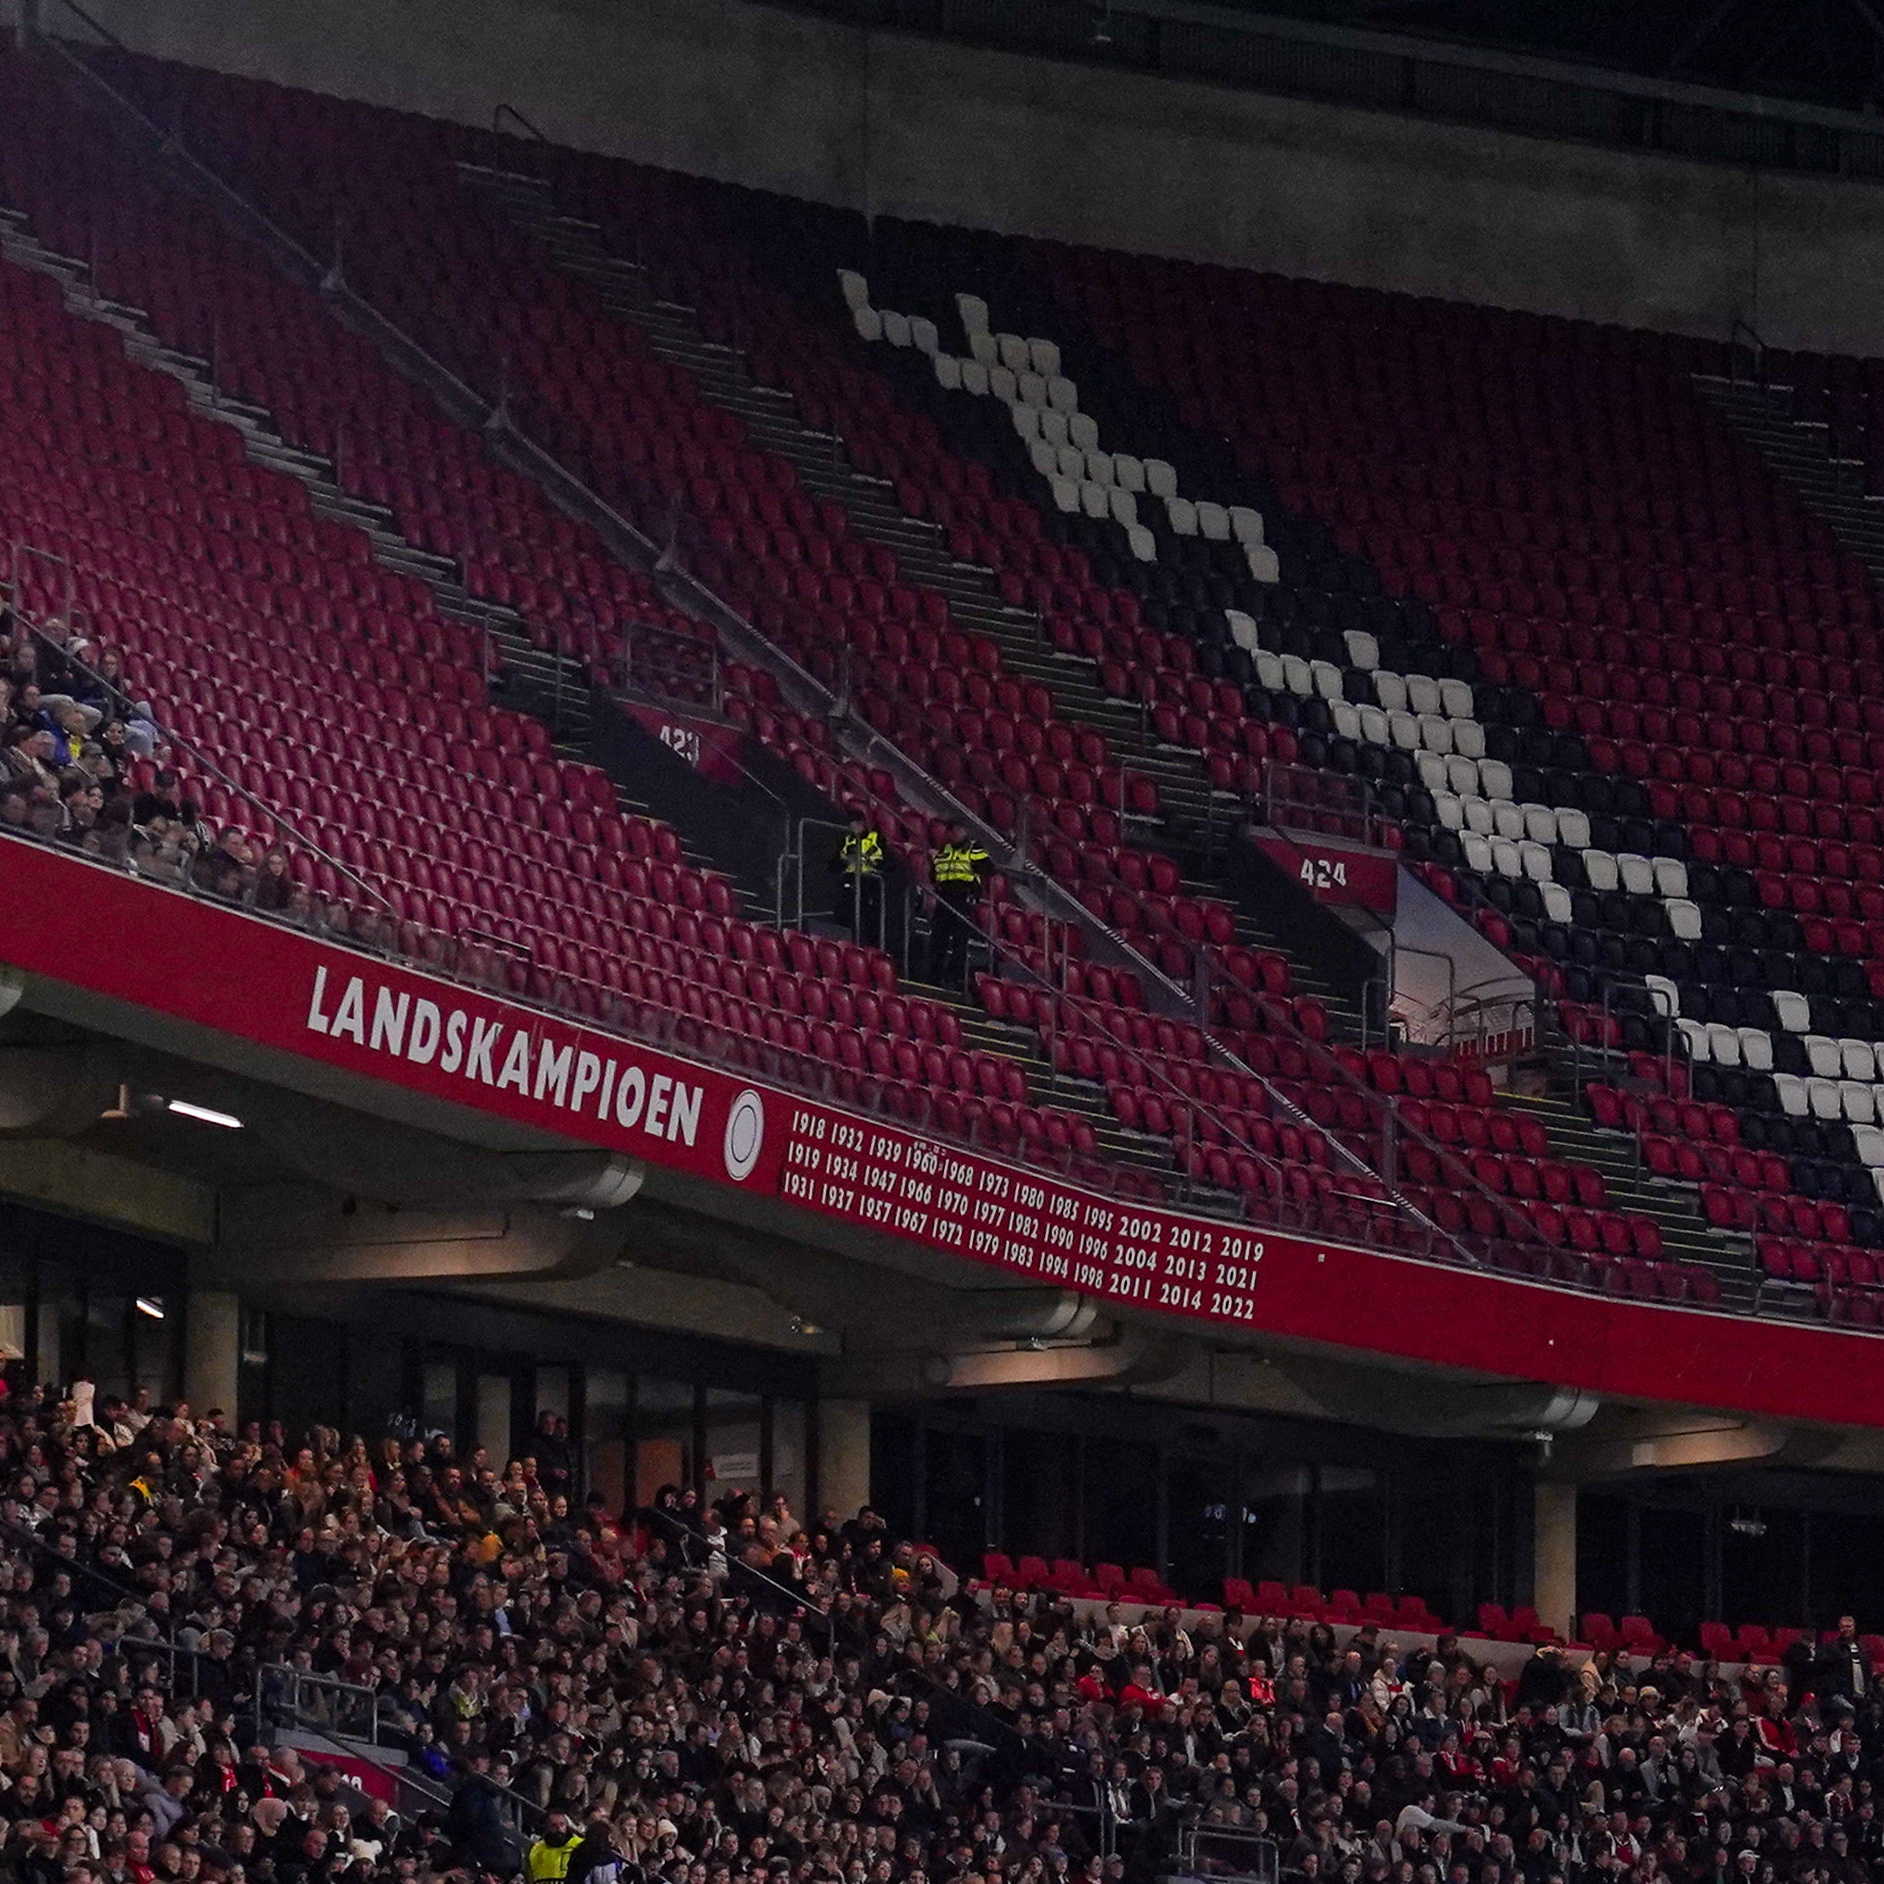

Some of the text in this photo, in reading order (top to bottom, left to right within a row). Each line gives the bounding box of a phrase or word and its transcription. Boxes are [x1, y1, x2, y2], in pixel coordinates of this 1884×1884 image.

[1301, 859, 1347, 888] 424
[307, 965, 704, 1147] LANDSKAMPIOEN
[785, 1172, 1253, 1319] 1931 1937 1957 1967 1972 1979 1983 1994 1998 2011 2014 2022
[789, 1142, 1256, 1290] 1919 1934 1947 1966 1970 1977 1982 1990 1996 2004 2013 2021
[793, 1111, 825, 1139] 1918
[831, 1124, 863, 1151] 1932
[869, 1136, 901, 1162] 1939
[943, 1159, 973, 1186] 1968
[979, 1171, 1009, 1197] 1973
[1015, 1183, 1044, 1209] 1980
[1050, 1194, 1079, 1220] 1985
[1085, 1206, 1113, 1231] 1995
[1119, 1216, 1161, 1242] 2002
[1169, 1227, 1211, 1252] 2012
[1221, 1237, 1263, 1261] 2019
